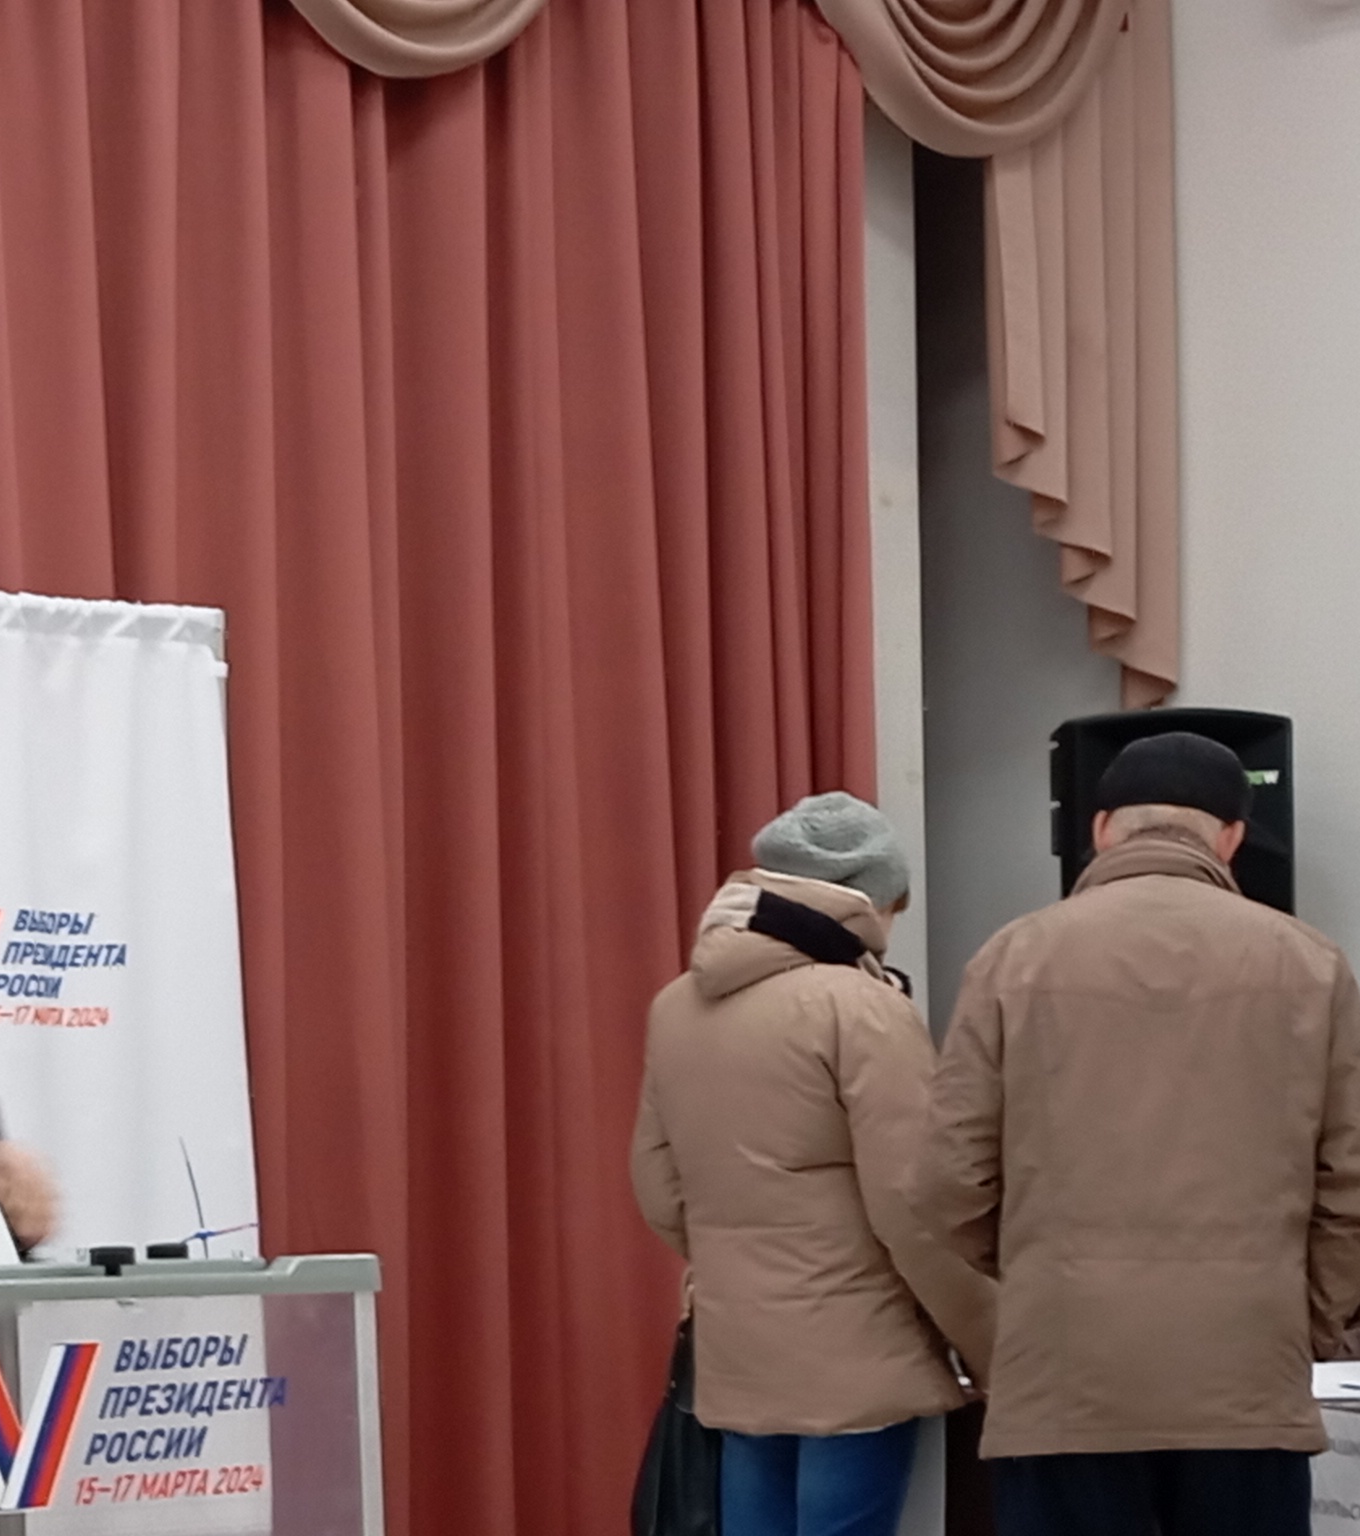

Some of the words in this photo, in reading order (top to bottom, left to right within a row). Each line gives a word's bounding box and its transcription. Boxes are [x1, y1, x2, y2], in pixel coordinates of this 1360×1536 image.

[13, 908, 95, 935] ВЫБОРЫ
[114, 1334, 248, 1373] ВЫБОРЫ
[99, 1377, 288, 1419] ПРЕЗИДЕНТА
[85, 1426, 208, 1465] РОССИИ
[139, 1469, 209, 1499] МАРТА
[212, 1465, 264, 1495] 2024
